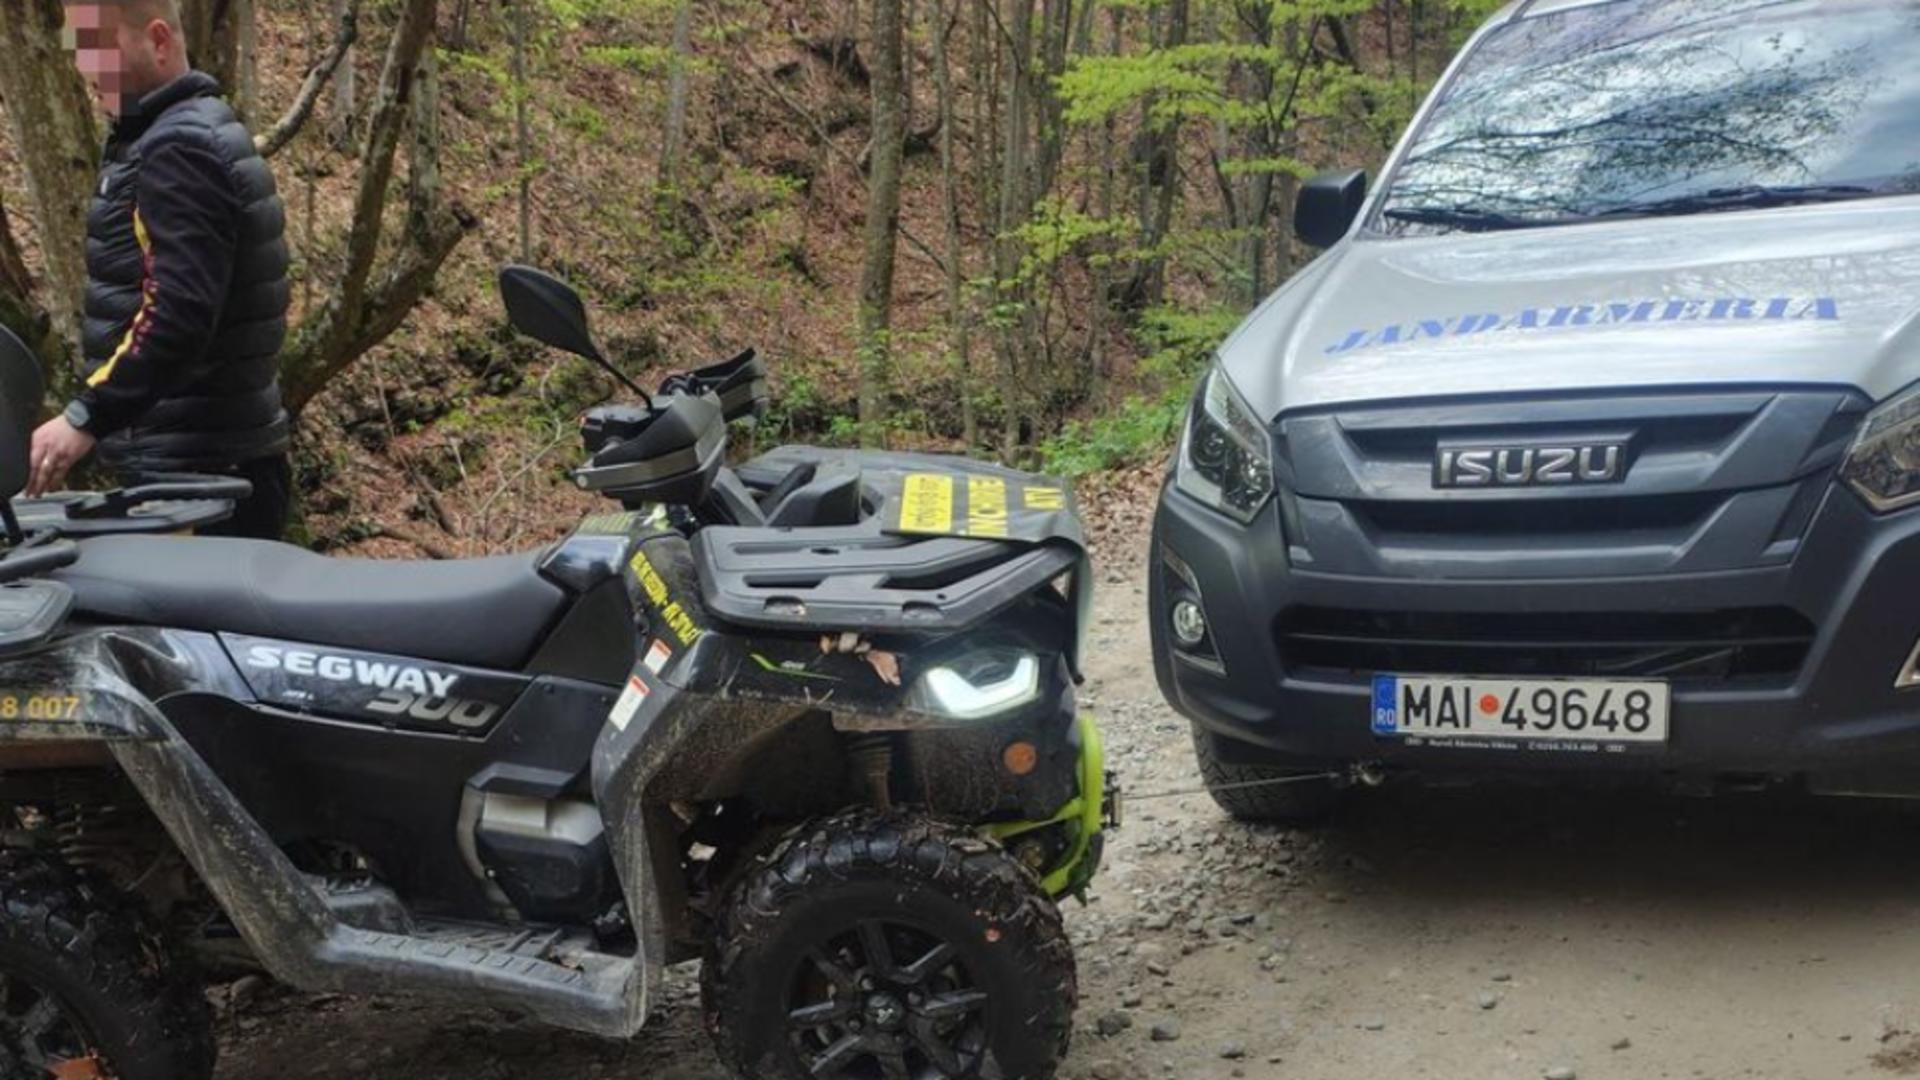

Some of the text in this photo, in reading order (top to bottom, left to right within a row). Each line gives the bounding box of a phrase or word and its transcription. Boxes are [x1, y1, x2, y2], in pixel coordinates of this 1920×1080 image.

[1325, 297, 1840, 355] JANDARMERIA
[1438, 445, 1619, 485] ISUZU
[246, 646, 459, 697] SEGWAY
[28, 695, 80, 720] 007
[1376, 708, 1395, 726] RO
[1402, 684, 1651, 733] MAI 49648
